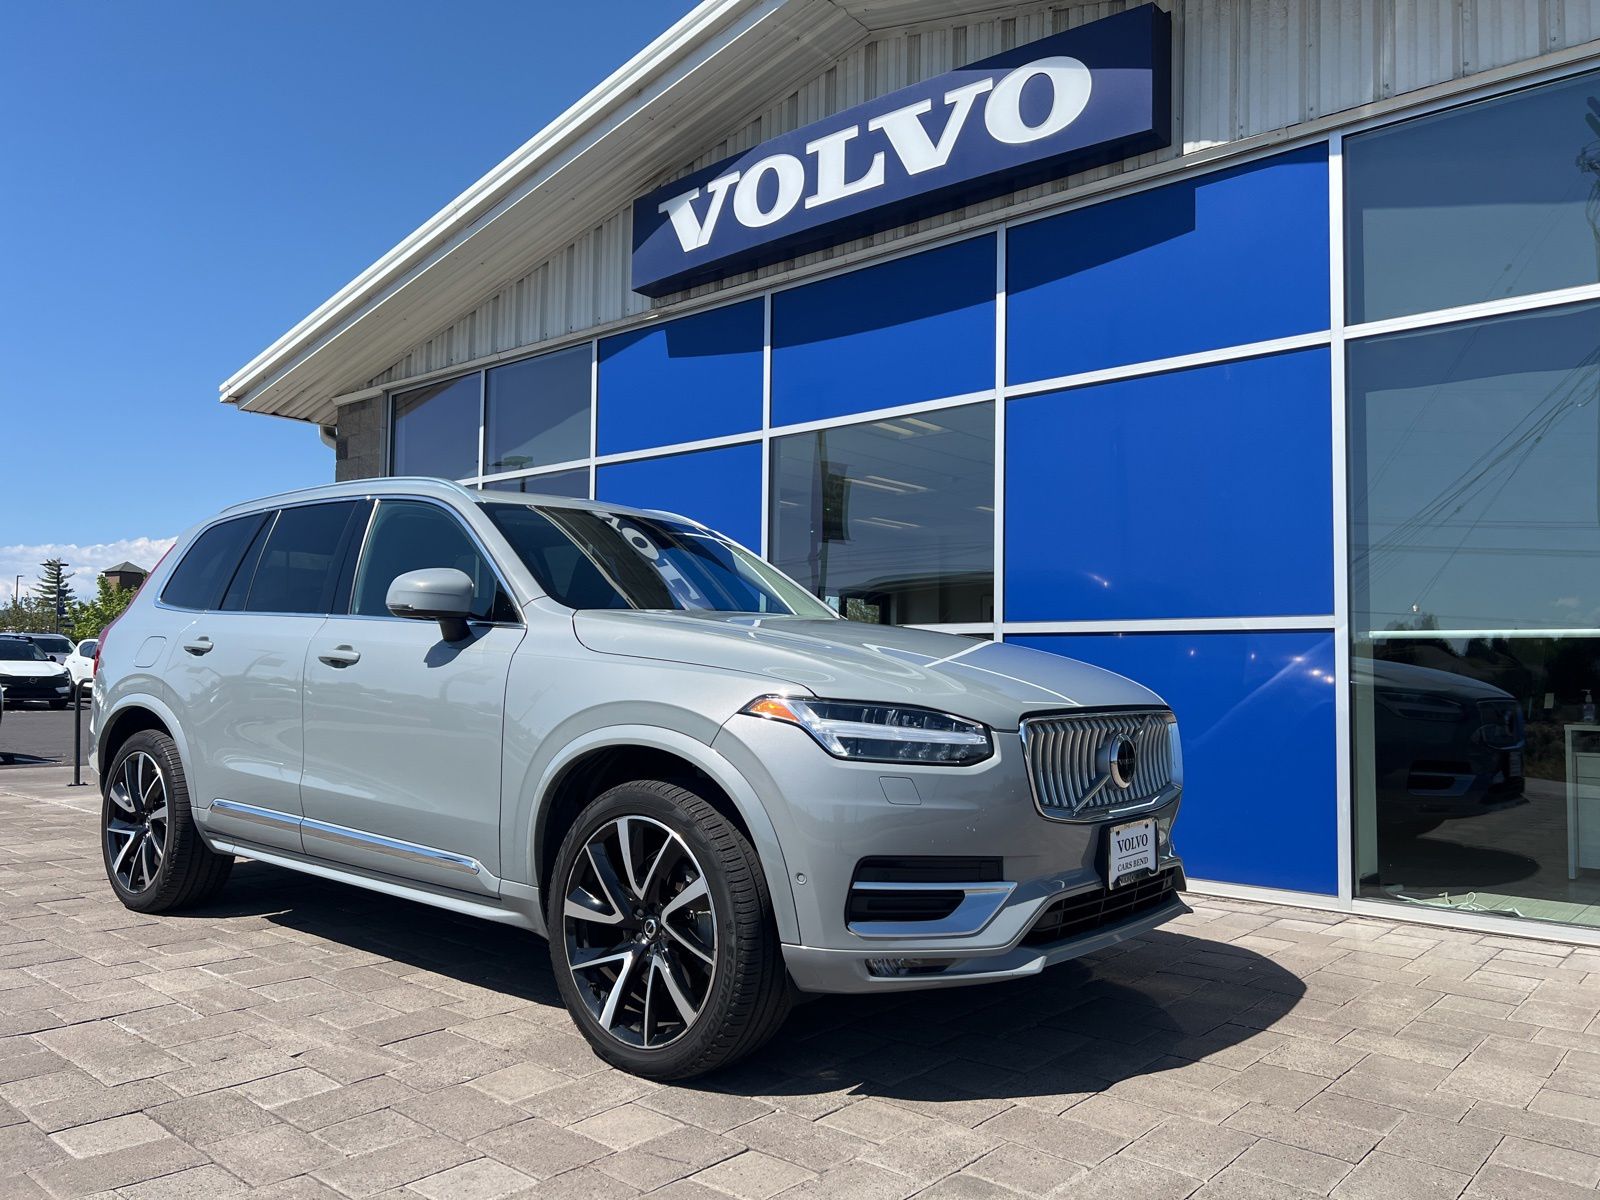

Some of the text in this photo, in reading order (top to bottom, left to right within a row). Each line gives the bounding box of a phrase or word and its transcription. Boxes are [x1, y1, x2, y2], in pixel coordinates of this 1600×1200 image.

[658, 55, 1092, 253] VOLVO
[1117, 833, 1148, 853] VOLVO
[1117, 856, 1149, 872] CARS BEND
